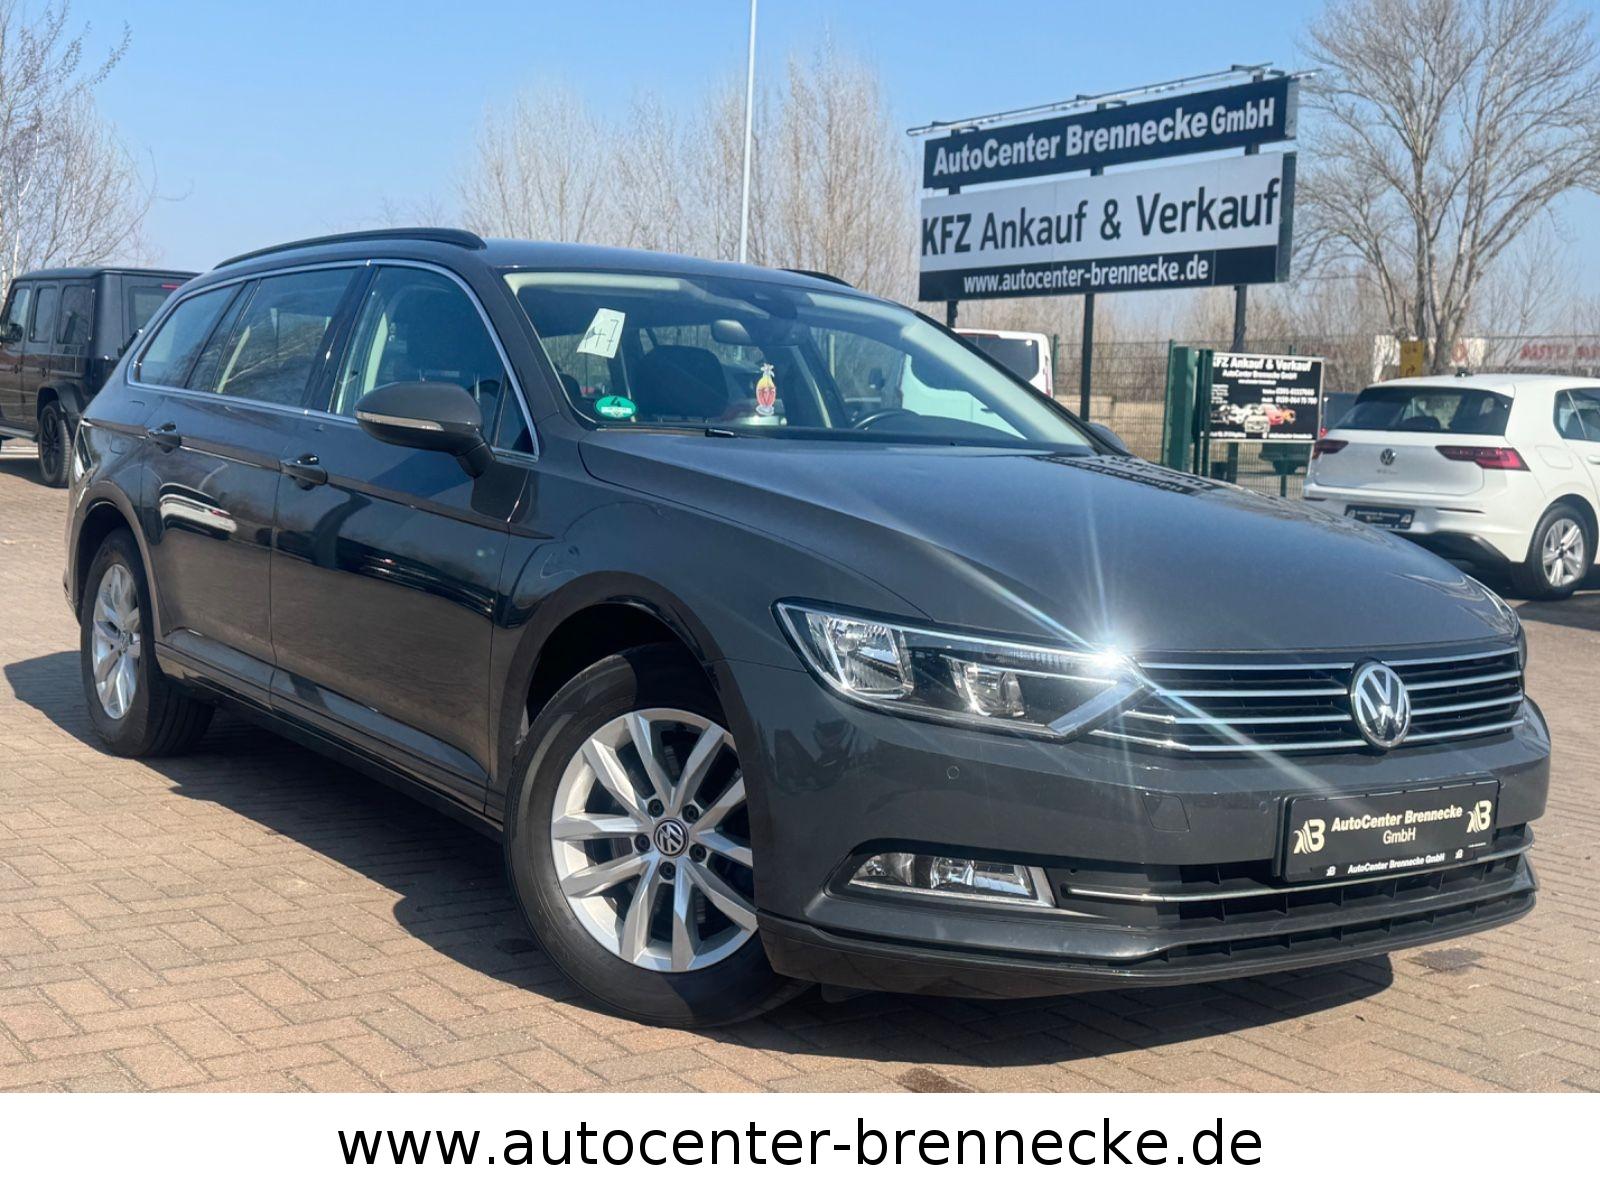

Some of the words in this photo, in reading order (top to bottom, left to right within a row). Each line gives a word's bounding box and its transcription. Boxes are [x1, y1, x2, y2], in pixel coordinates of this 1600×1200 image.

[933, 129, 1060, 176] AutoCenter
[1065, 107, 1208, 157] Brennecke
[1210, 97, 1275, 134] GmbH
[921, 213, 972, 257] KFZ
[980, 200, 1089, 251] Ankauf
[1099, 198, 1121, 241] &
[1136, 178, 1280, 237] Verkauf
[963, 256, 1209, 294] www.autocenter-brennecke.de
[1331, 813, 1401, 833] AutoCenter
[1404, 804, 1463, 826] Brennecke
[1382, 827, 1416, 845] GmbH
[1347, 862, 1388, 874] AutoCenter
[1389, 857, 1425, 869] Brennecke
[1425, 853, 1445, 863] GmbH
